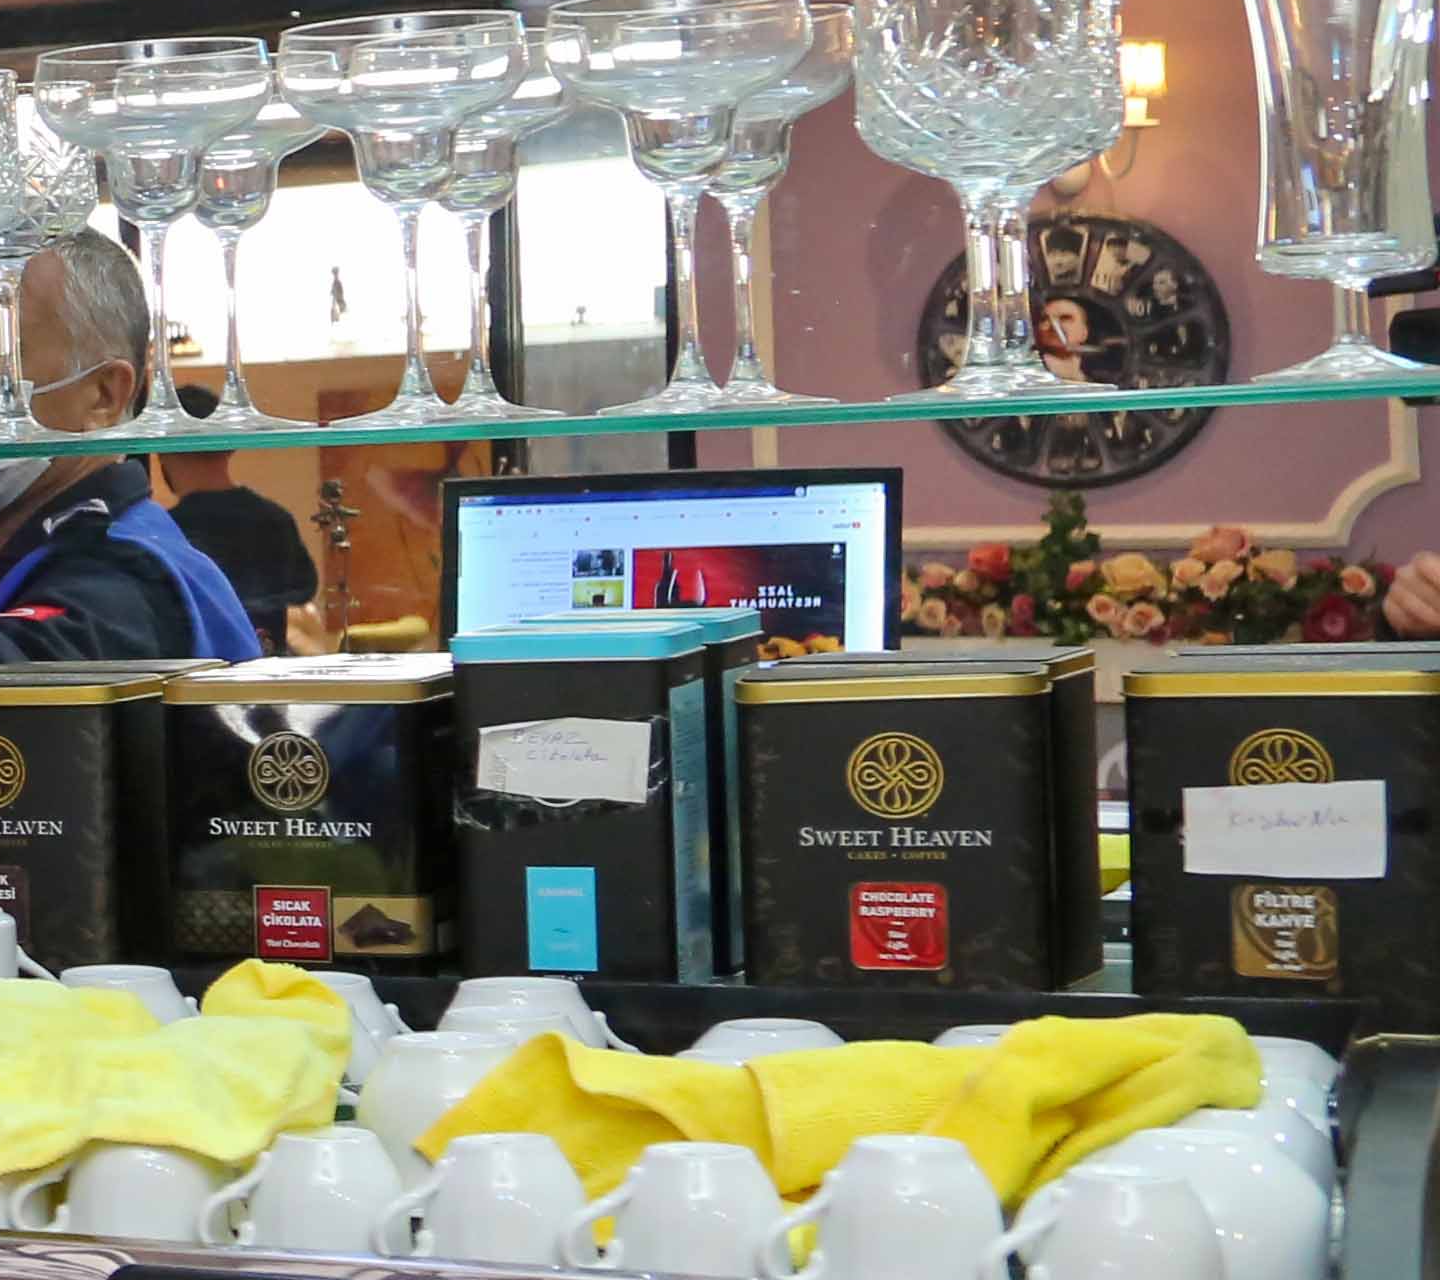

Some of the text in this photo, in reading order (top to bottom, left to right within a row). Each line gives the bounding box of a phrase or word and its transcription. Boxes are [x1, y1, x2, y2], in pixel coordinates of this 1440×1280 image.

[209, 817, 373, 838] SWEET HEAVEN
[799, 826, 993, 847] SWEET HEAVEN
[859, 891, 935, 903] CHOCOLATE
[1253, 891, 1316, 909] FİLTRE
[272, 900, 311, 911] SICAK
[858, 906, 936, 918] RASPBERRY
[262, 912, 323, 928] ÇİKOLATA
[1254, 913, 1316, 928] KAHVE
